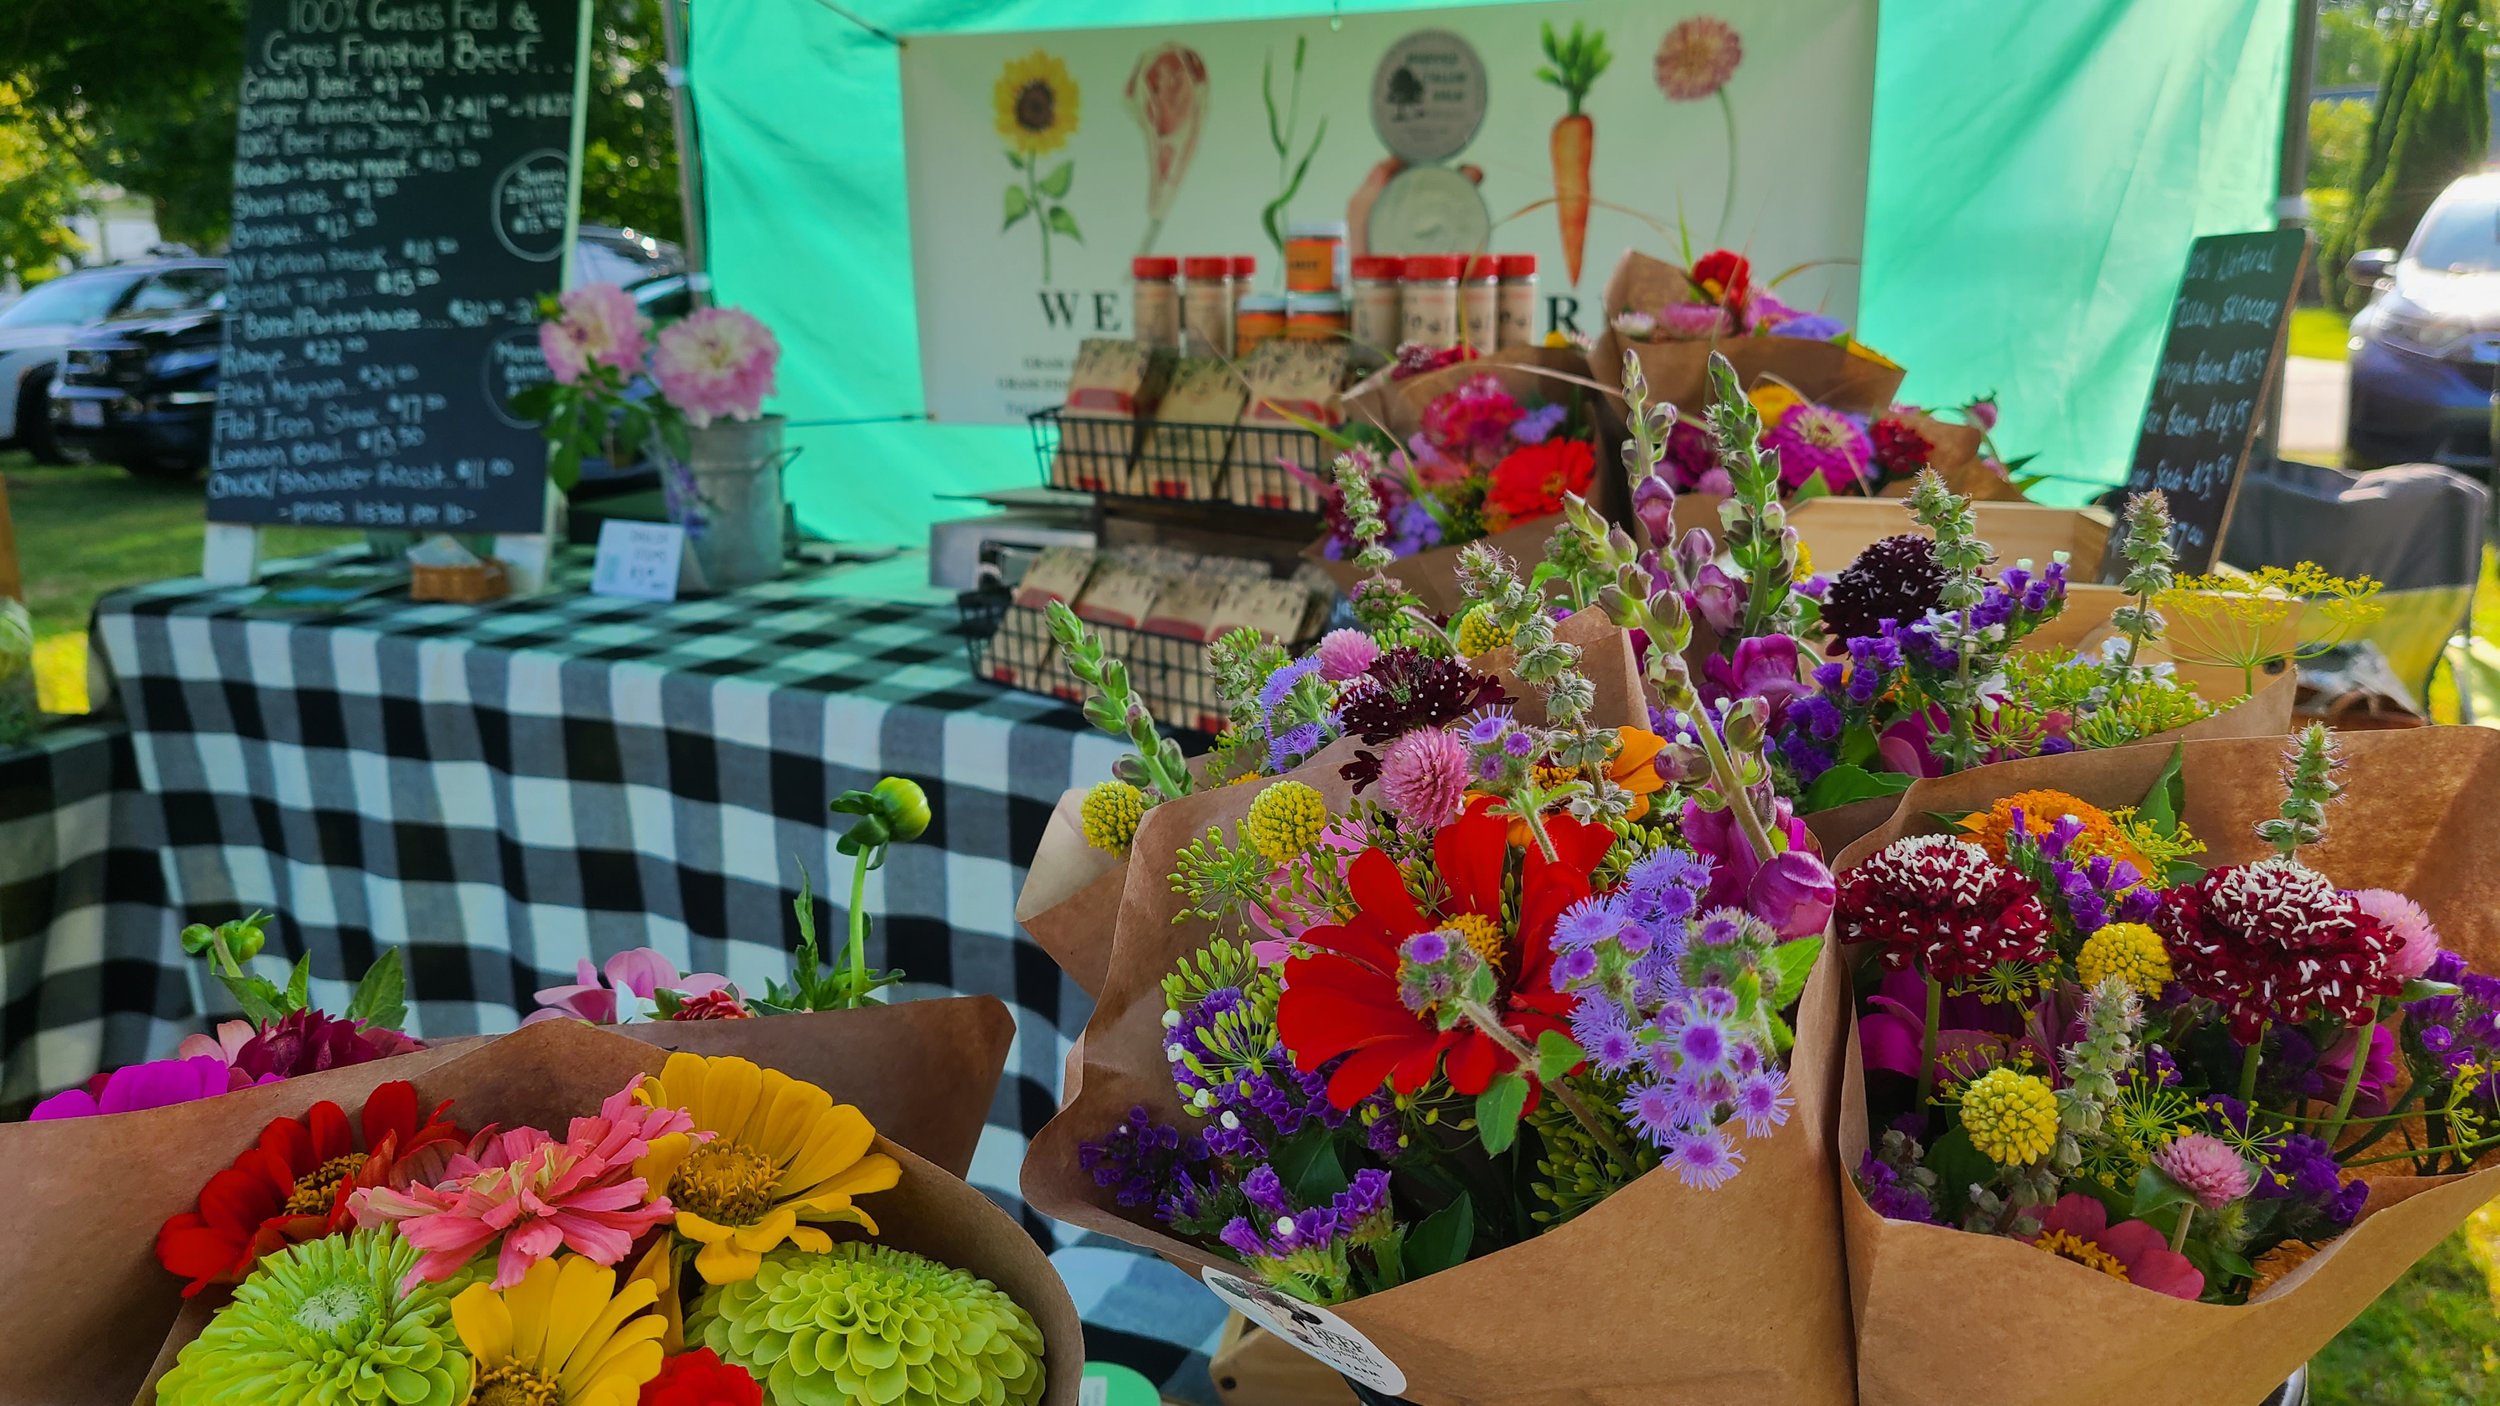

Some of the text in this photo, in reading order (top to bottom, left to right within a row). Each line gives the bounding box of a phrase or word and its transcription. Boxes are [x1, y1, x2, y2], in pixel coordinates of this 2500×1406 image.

[366, 0, 445, 31] Grass
[262, 30, 544, 74] Grass Finished Beef
[1038, 289, 1121, 332] WE
